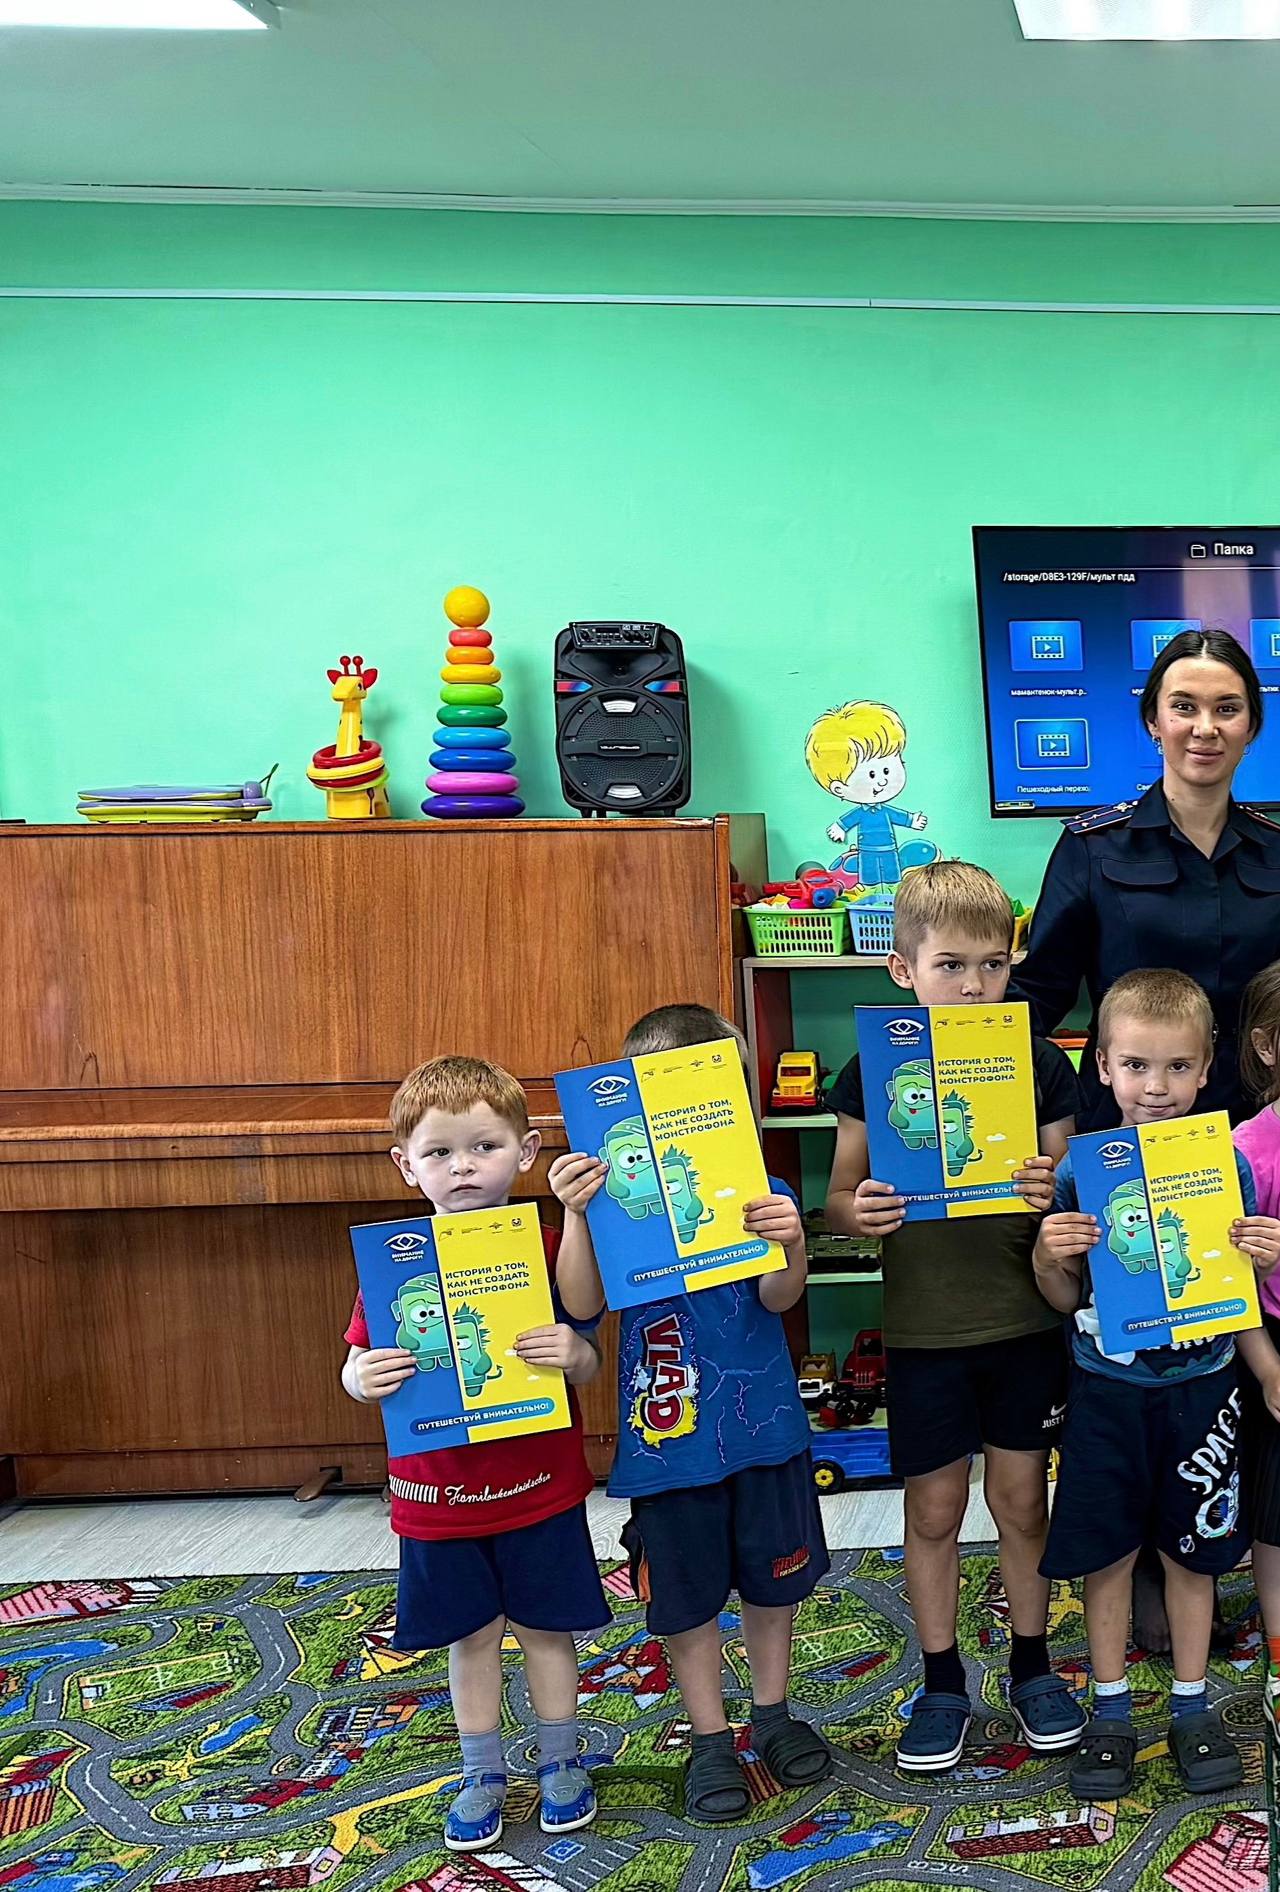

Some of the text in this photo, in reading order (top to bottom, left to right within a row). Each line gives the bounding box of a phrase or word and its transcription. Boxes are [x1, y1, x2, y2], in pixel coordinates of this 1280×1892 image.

[1213, 542, 1254, 556] Папка
[1117, 574, 1135, 583] пдд
[1017, 785, 1063, 794] Пешеходный
[938, 1058, 981, 1066] ИСТОРИЯ
[974, 1066, 1015, 1074] СОЗДАТЬ
[940, 1075, 1014, 1084] МОНСТРОФОНА
[650, 1106, 696, 1121] ИСТОРИЯ
[708, 1098, 732, 1110] ТОМ,
[652, 1108, 734, 1131] КАК НЕ СОЗДАТЬ
[655, 1118, 735, 1141] МОНСТРОФОНА
[1150, 1172, 1190, 1185] ИСТОРИЯ
[1151, 1177, 1223, 1194] КАК НЕ СОЗДАТЬ
[1153, 1186, 1223, 1203] МОНСТРОФОНА
[446, 1267, 491, 1279] ИСТОРИЯ
[504, 1261, 528, 1271] ТОМ,
[633, 1244, 764, 1282] ПУТЕШЕСТВУЙ ВНИМАТЕЛЬНО!
[447, 1280, 468, 1289] КАК
[485, 1271, 529, 1284] СОЗДАТЬ
[449, 1281, 529, 1298] МОНСТРОФОНА
[1128, 1314, 1183, 1331] ПУТЕШЕСТВУЙ
[640, 1313, 688, 1432] VLAD
[418, 1403, 549, 1431] ПУТЕШЕСТВУЙ ВНИМАТЕЛЬНО!
[1042, 1416, 1060, 1429] JUST
